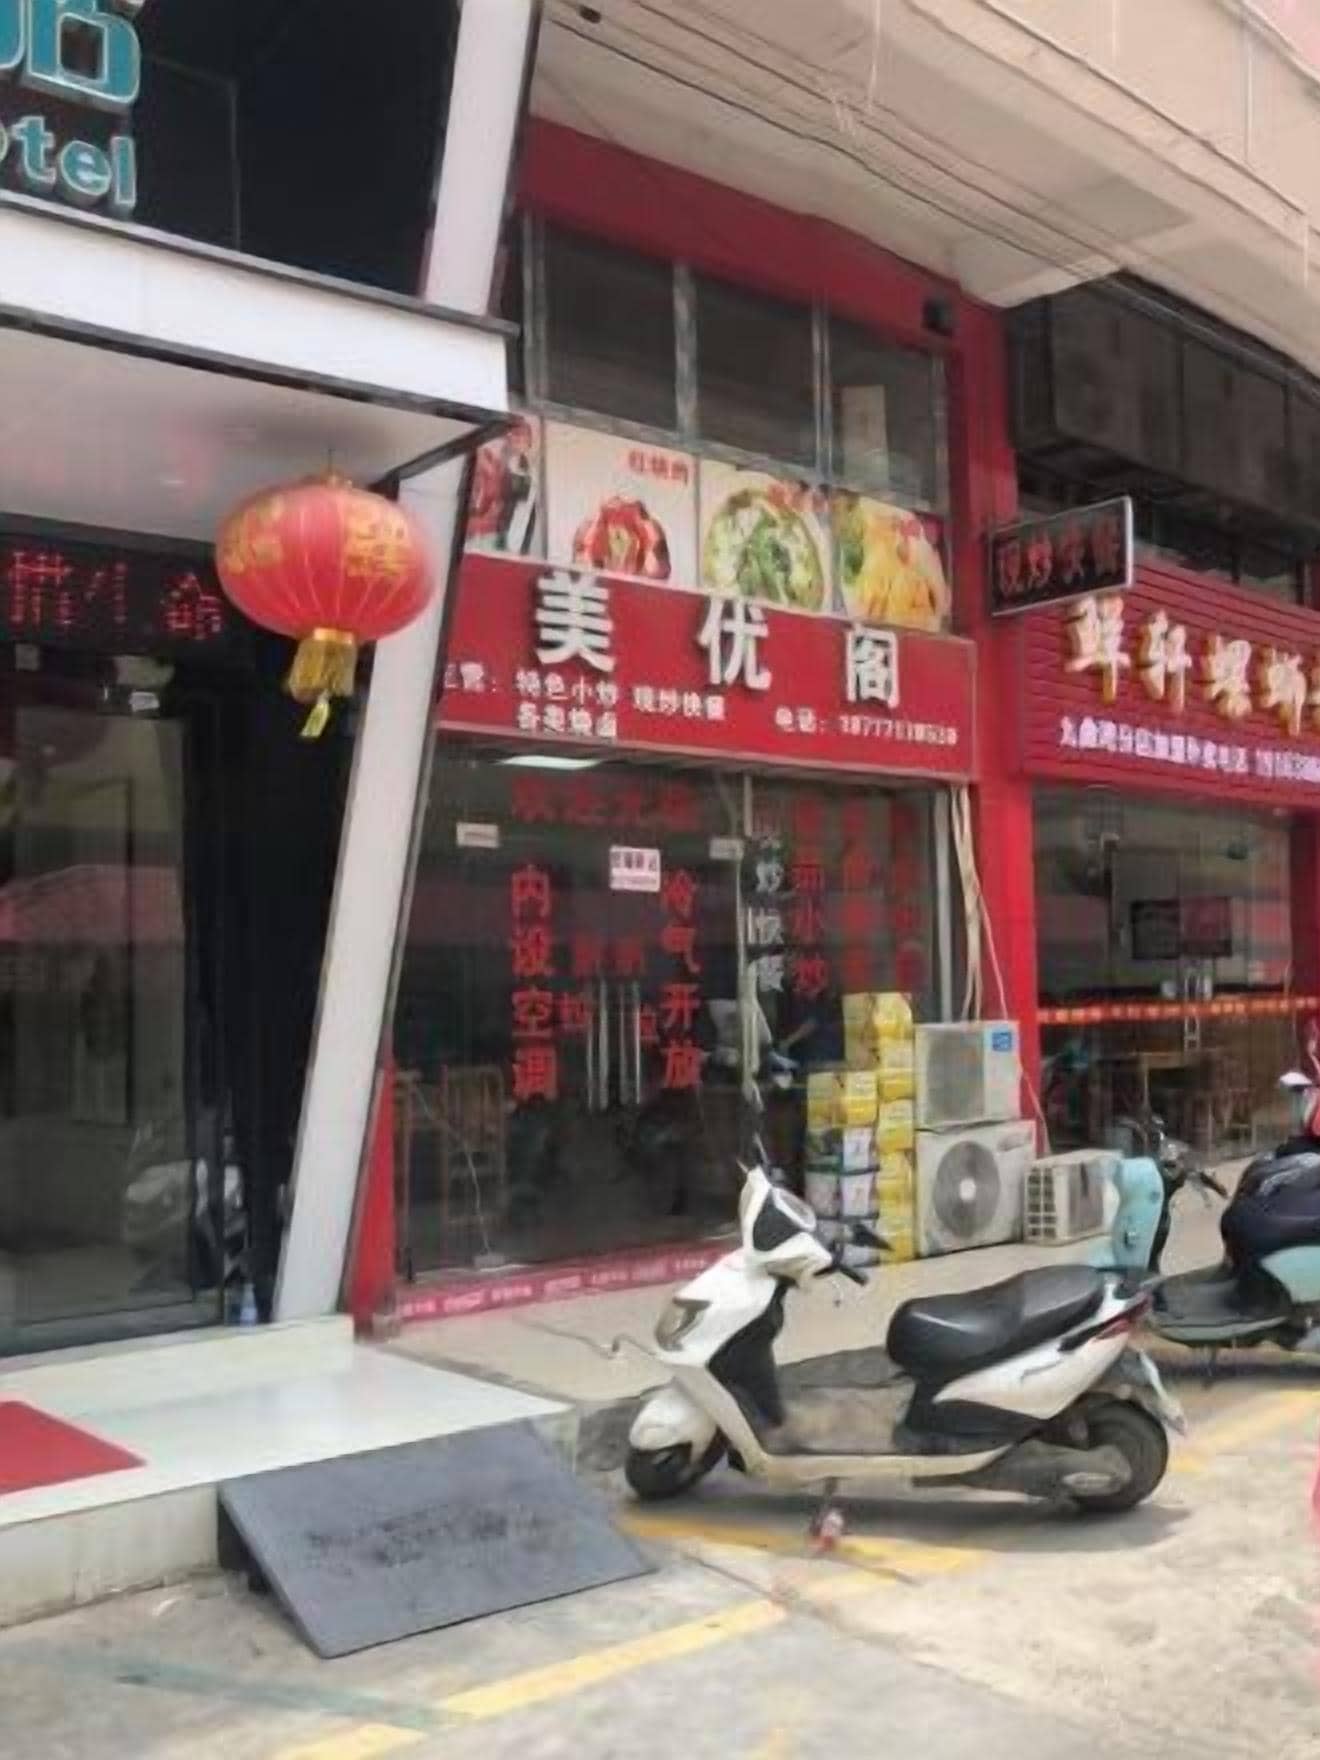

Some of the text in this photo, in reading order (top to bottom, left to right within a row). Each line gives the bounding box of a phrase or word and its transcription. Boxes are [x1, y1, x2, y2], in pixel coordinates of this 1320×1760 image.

[0, 0, 142, 105] B
[0, 115, 138, 207] tel
[534, 566, 899, 709] 美优阁
[510, 862, 560, 1103] 内设空调
[660, 867, 706, 1092] 冷气开放
